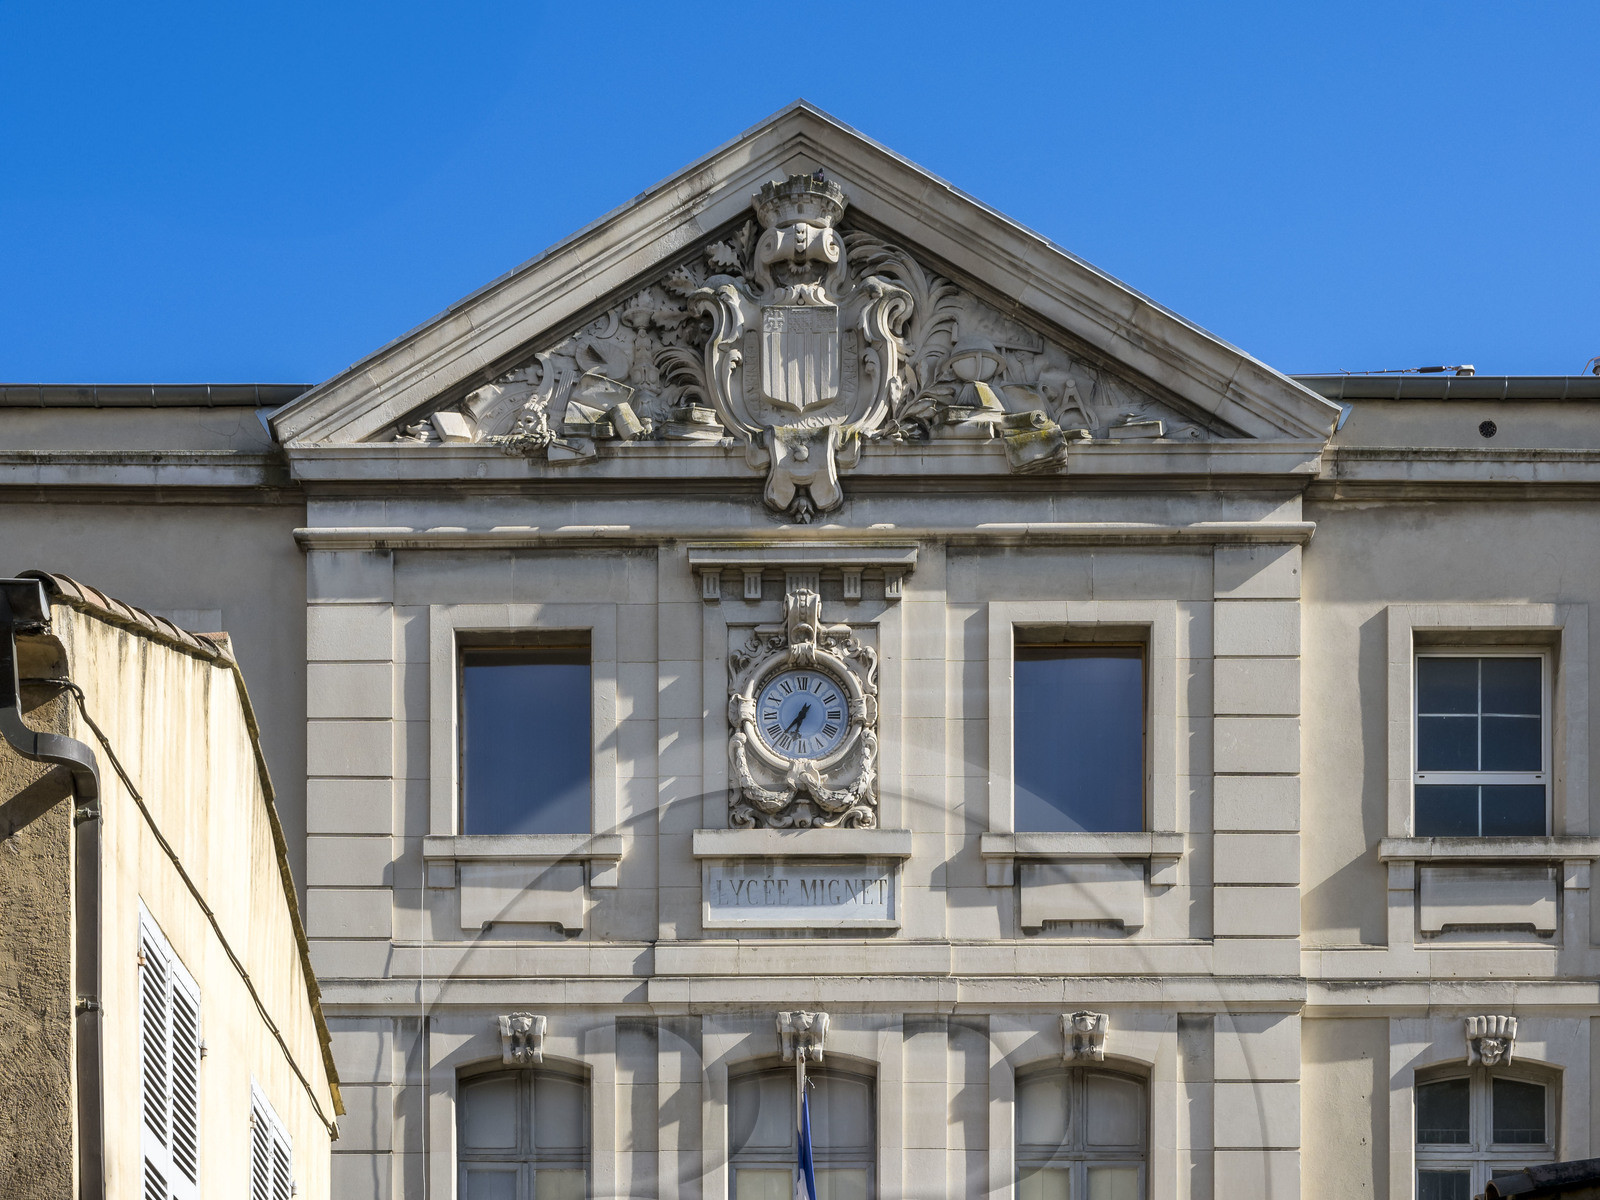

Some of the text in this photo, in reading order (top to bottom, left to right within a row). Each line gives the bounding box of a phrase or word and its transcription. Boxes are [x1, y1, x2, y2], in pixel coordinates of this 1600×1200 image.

[827, 710, 841, 720] III
[716, 875, 888, 906] LYCÉE MIGNET
